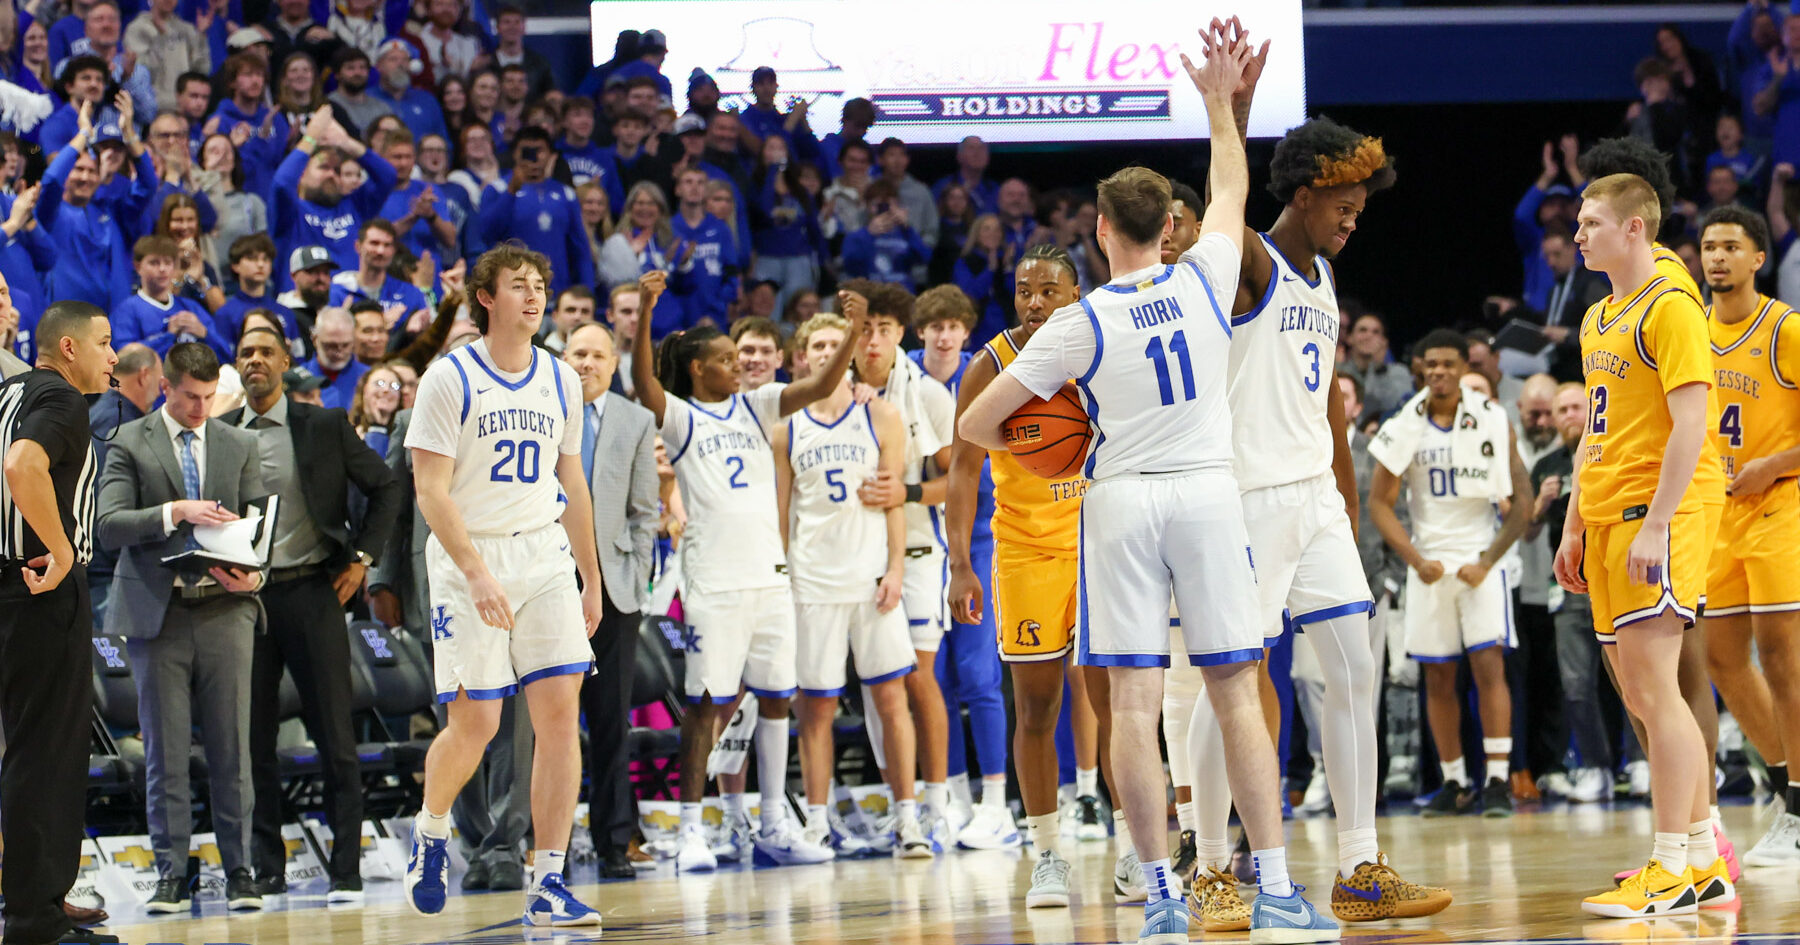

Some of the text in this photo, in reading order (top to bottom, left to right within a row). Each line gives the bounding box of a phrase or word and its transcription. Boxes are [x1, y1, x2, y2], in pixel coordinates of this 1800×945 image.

[1036, 22, 1180, 82] Flex
[940, 95, 1102, 117] HOLDINGS
[1129, 297, 1184, 330] HORN
[1145, 330, 1196, 406] 11
[1302, 342, 1320, 392] 3
[1714, 369, 1760, 399] ESSEE
[478, 408, 554, 439] KENTUCKY
[1588, 385, 1607, 435] 12
[1718, 404, 1742, 447] 4
[490, 439, 540, 484] 20
[697, 431, 761, 459] KENTUCKY
[798, 443, 867, 473] KENTUCKY
[726, 456, 748, 488] 2
[825, 468, 847, 503] 5
[1050, 480, 1088, 502] TECH
